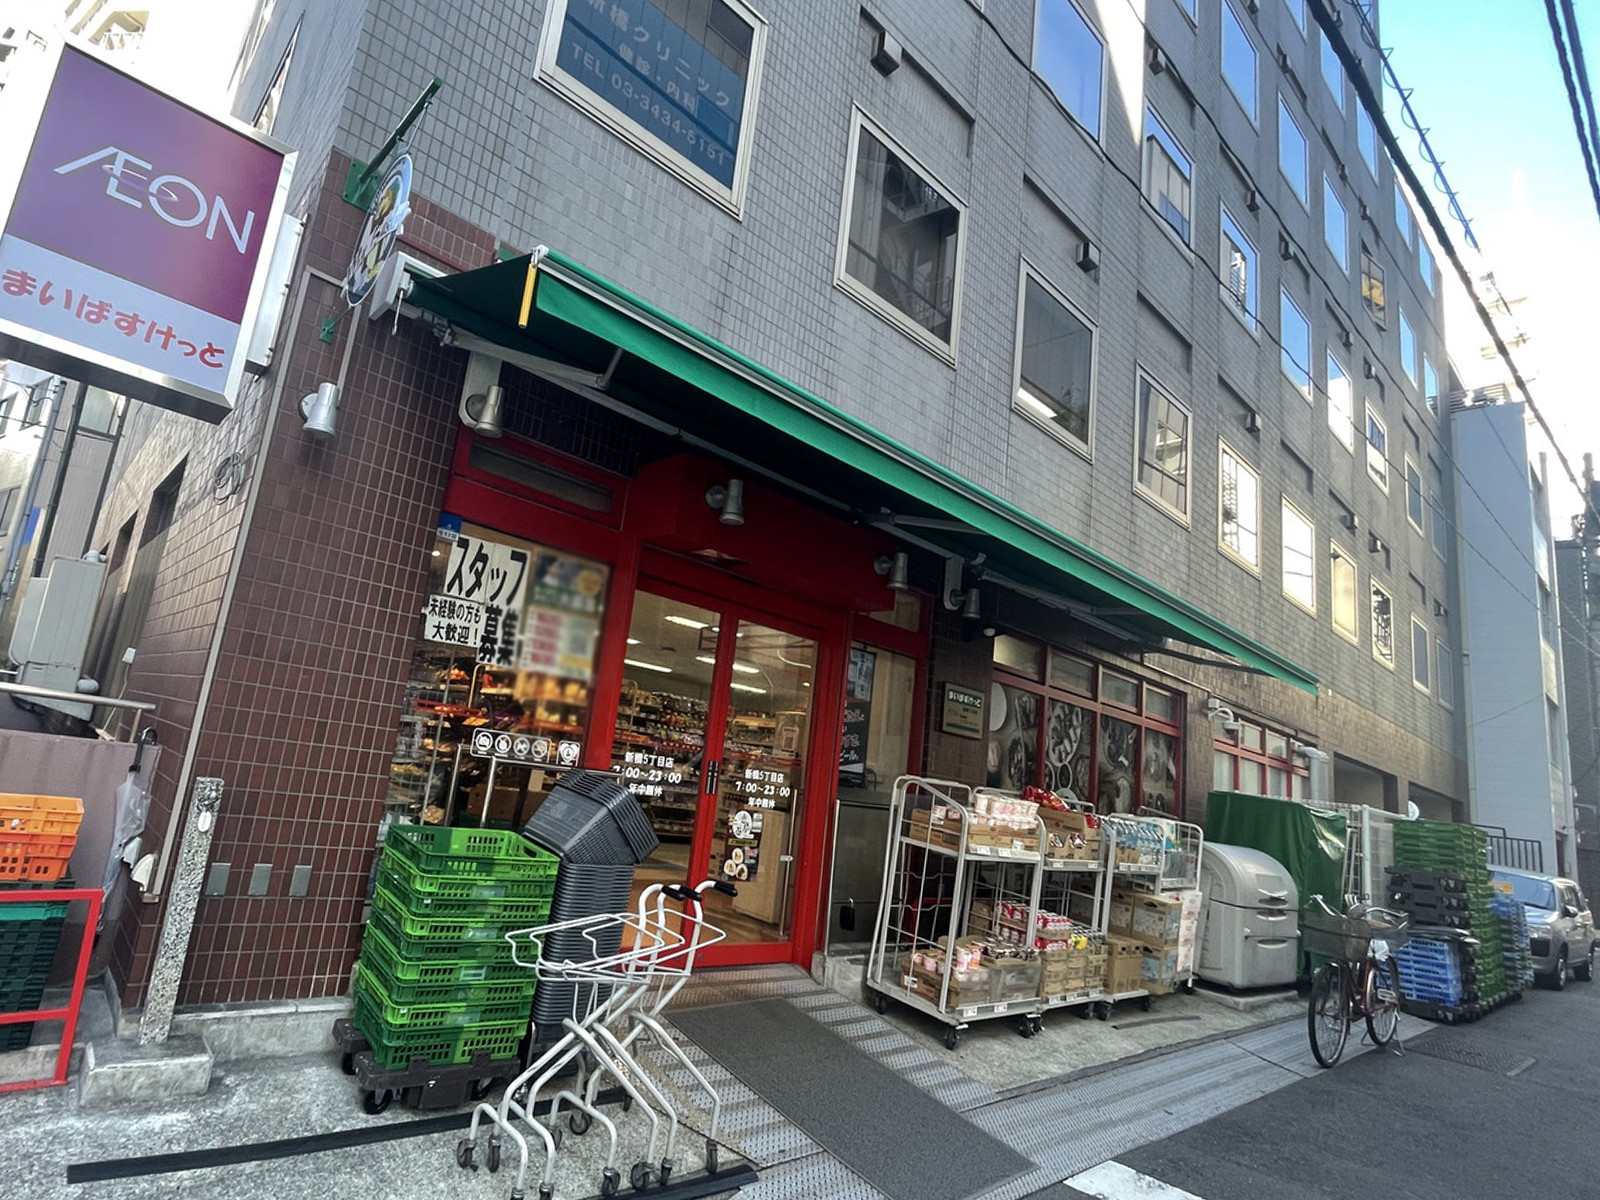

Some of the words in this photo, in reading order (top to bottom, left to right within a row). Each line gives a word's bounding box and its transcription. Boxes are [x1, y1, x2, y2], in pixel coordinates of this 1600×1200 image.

[572, 42, 605, 79] TEL
[2, 266, 225, 369] まいばすけっと
[446, 535, 528, 606] スタッフ
[428, 597, 481, 624] 未経験の方も
[432, 621, 478, 645] 大歓迎！
